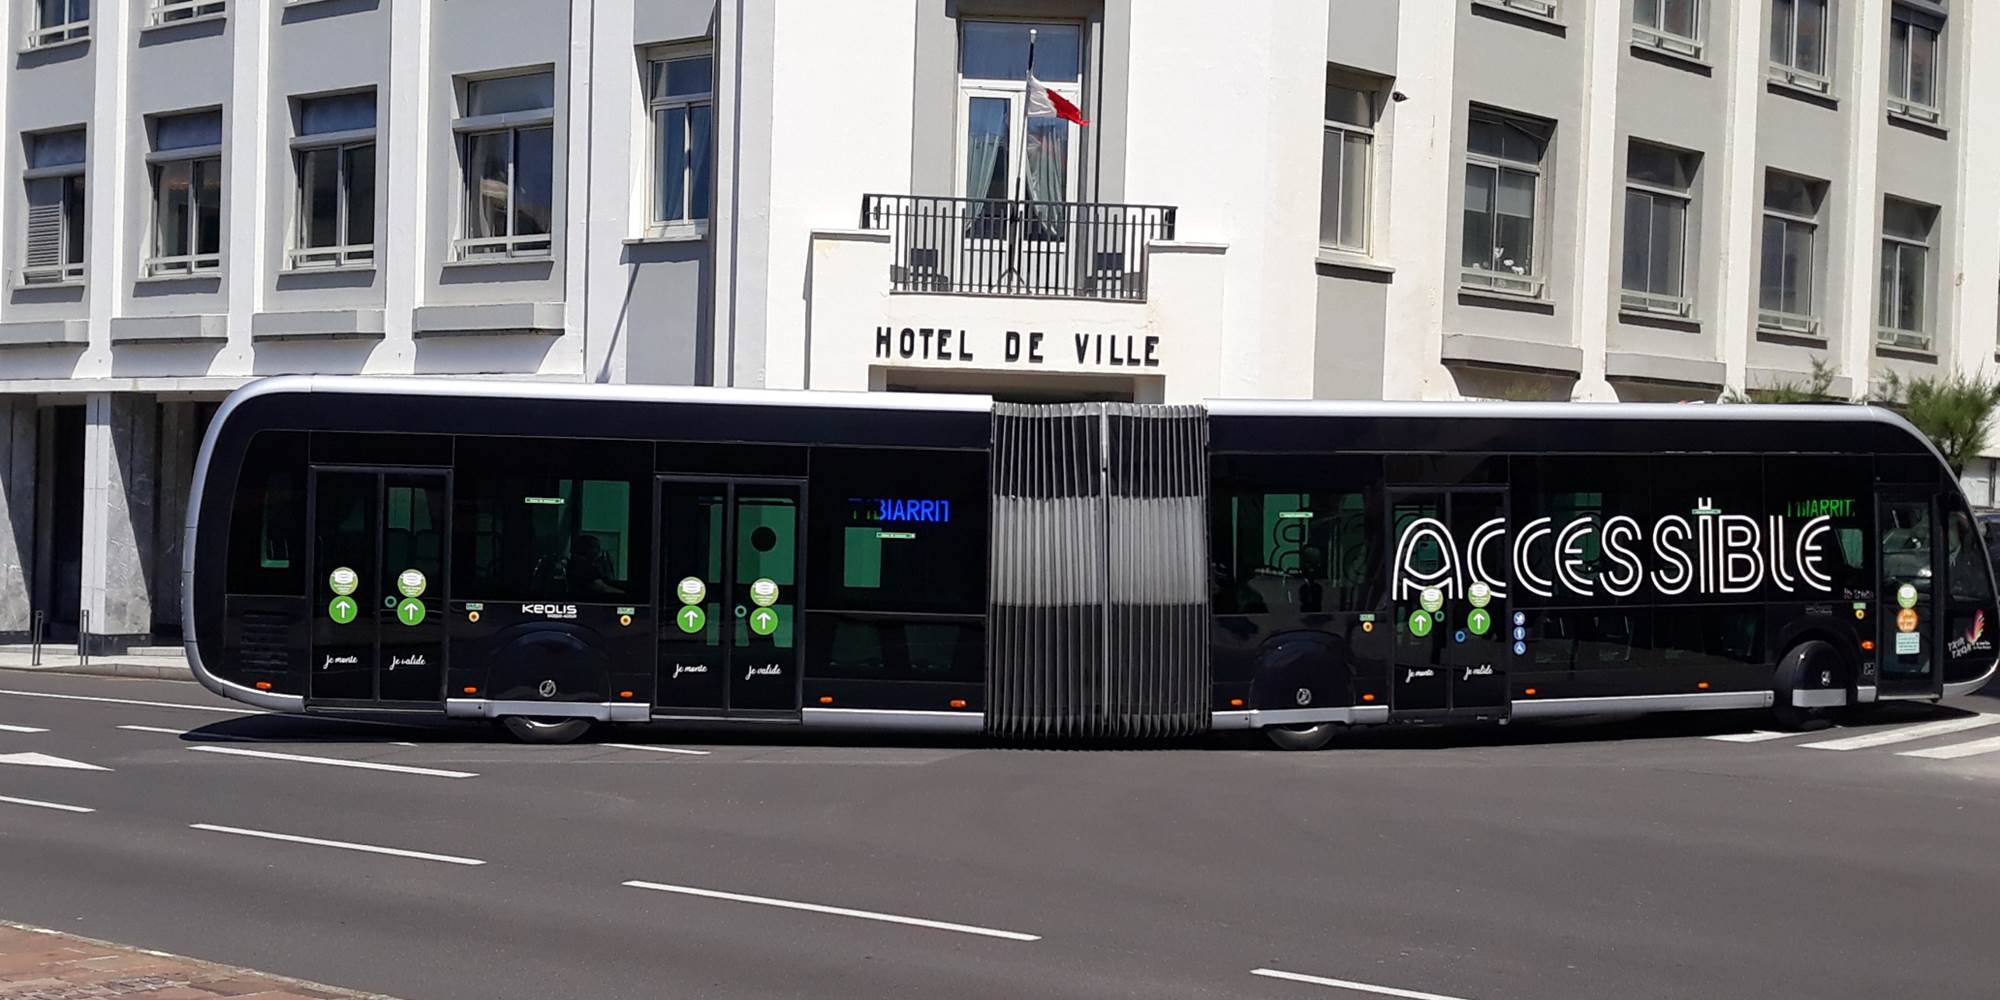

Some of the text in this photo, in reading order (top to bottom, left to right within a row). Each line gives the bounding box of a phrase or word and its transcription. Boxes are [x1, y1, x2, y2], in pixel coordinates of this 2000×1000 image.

[875, 326, 1160, 367] HOTEL DE VILLE
[1392, 497, 1832, 601] ACCESSIBLE
